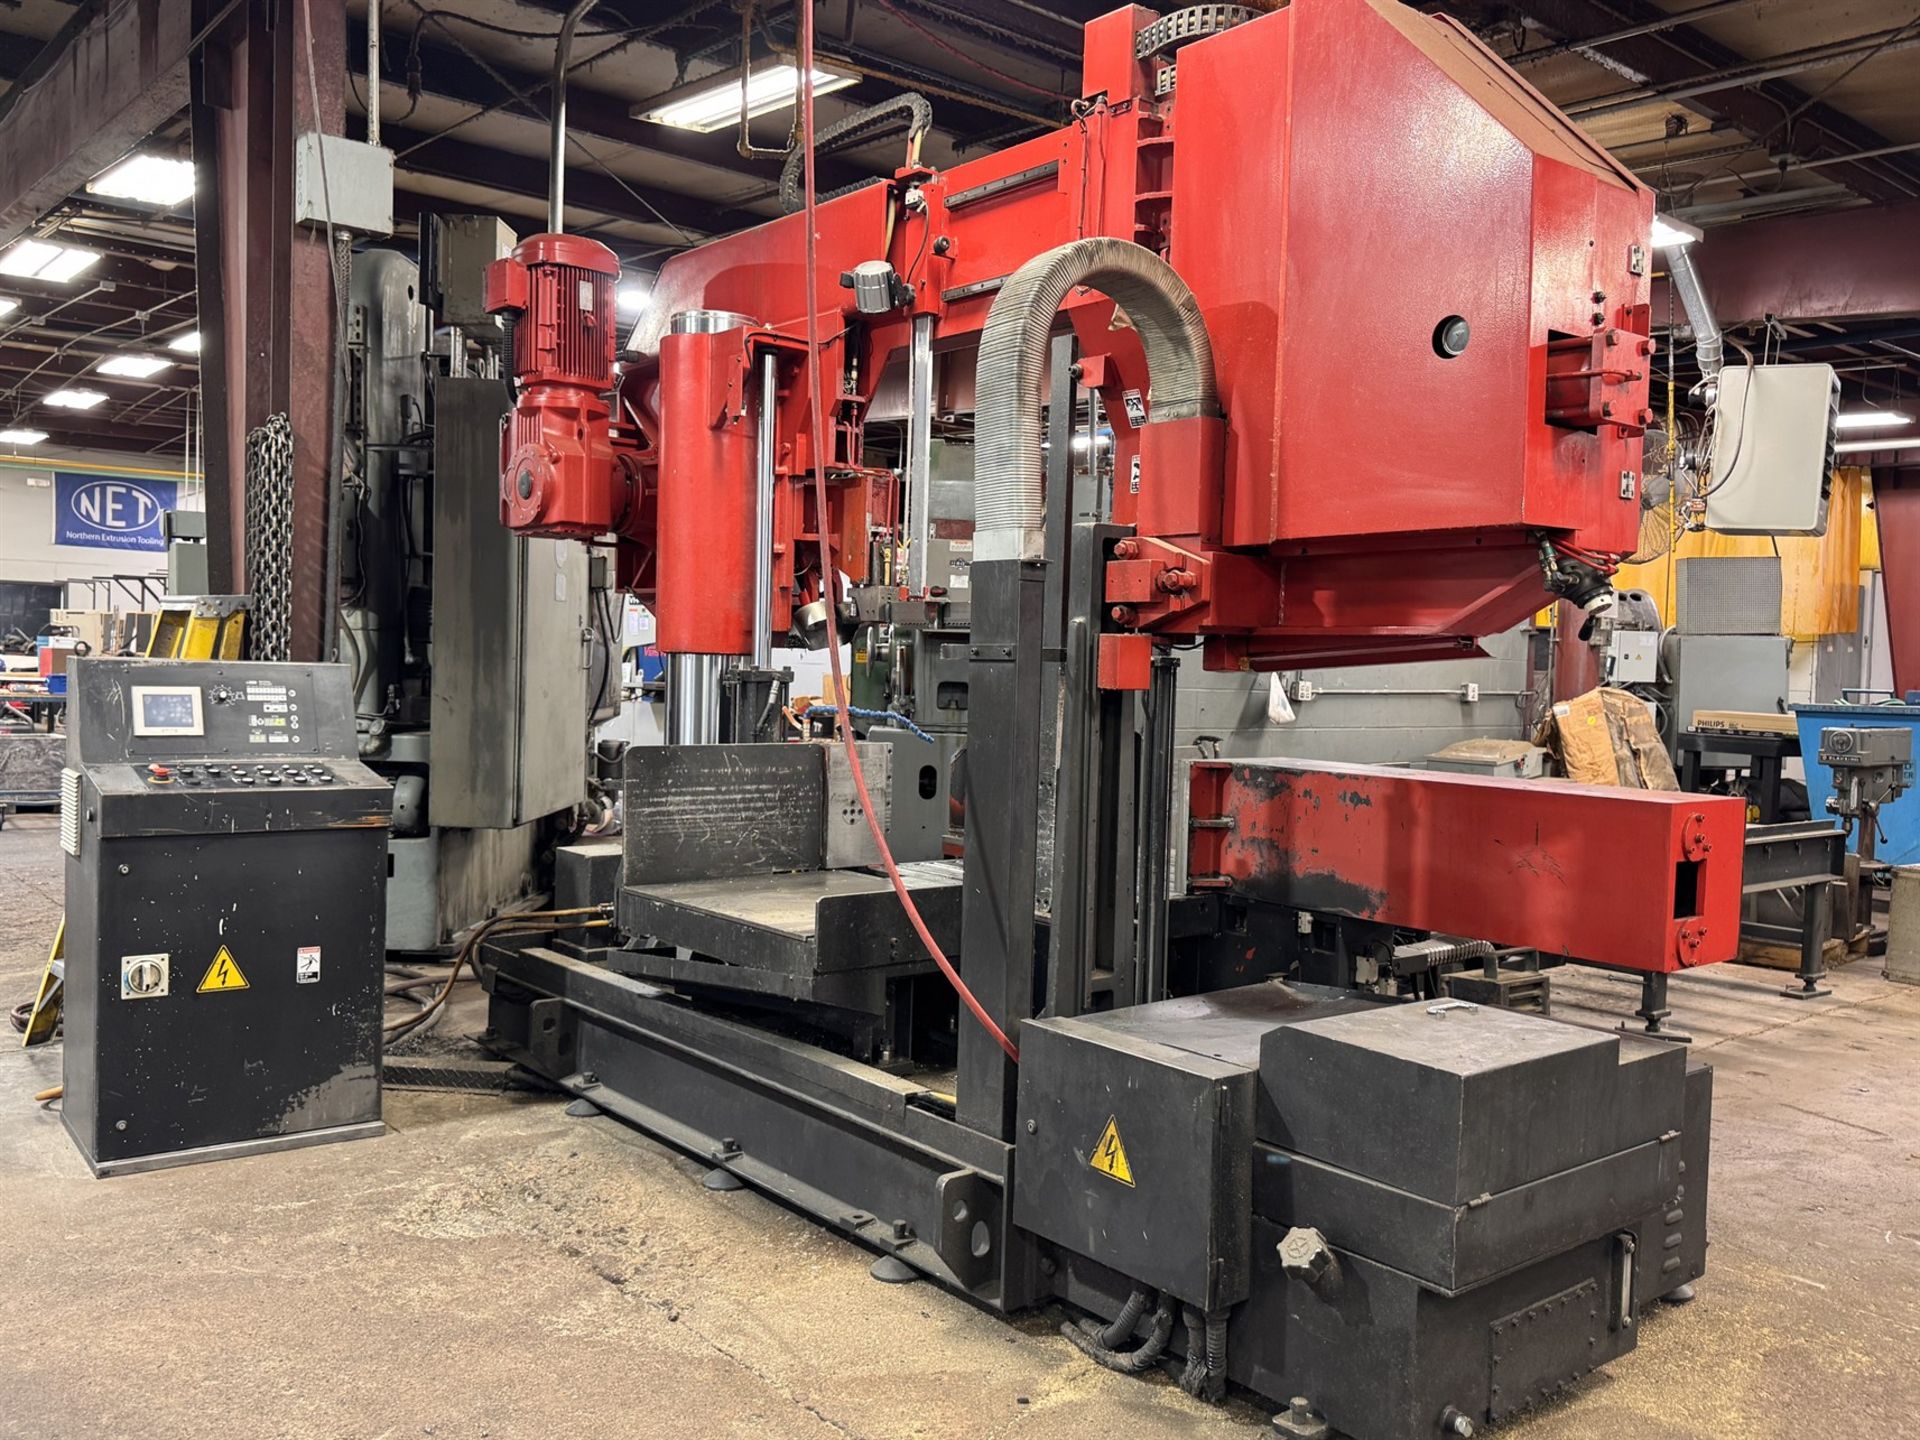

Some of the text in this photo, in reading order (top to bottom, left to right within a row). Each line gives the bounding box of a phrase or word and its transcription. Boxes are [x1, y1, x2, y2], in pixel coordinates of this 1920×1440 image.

[79, 486, 152, 528] NET
[66, 530, 164, 547] Northern Extrusion Tooling
[1697, 719, 1725, 728] PHILIPS
